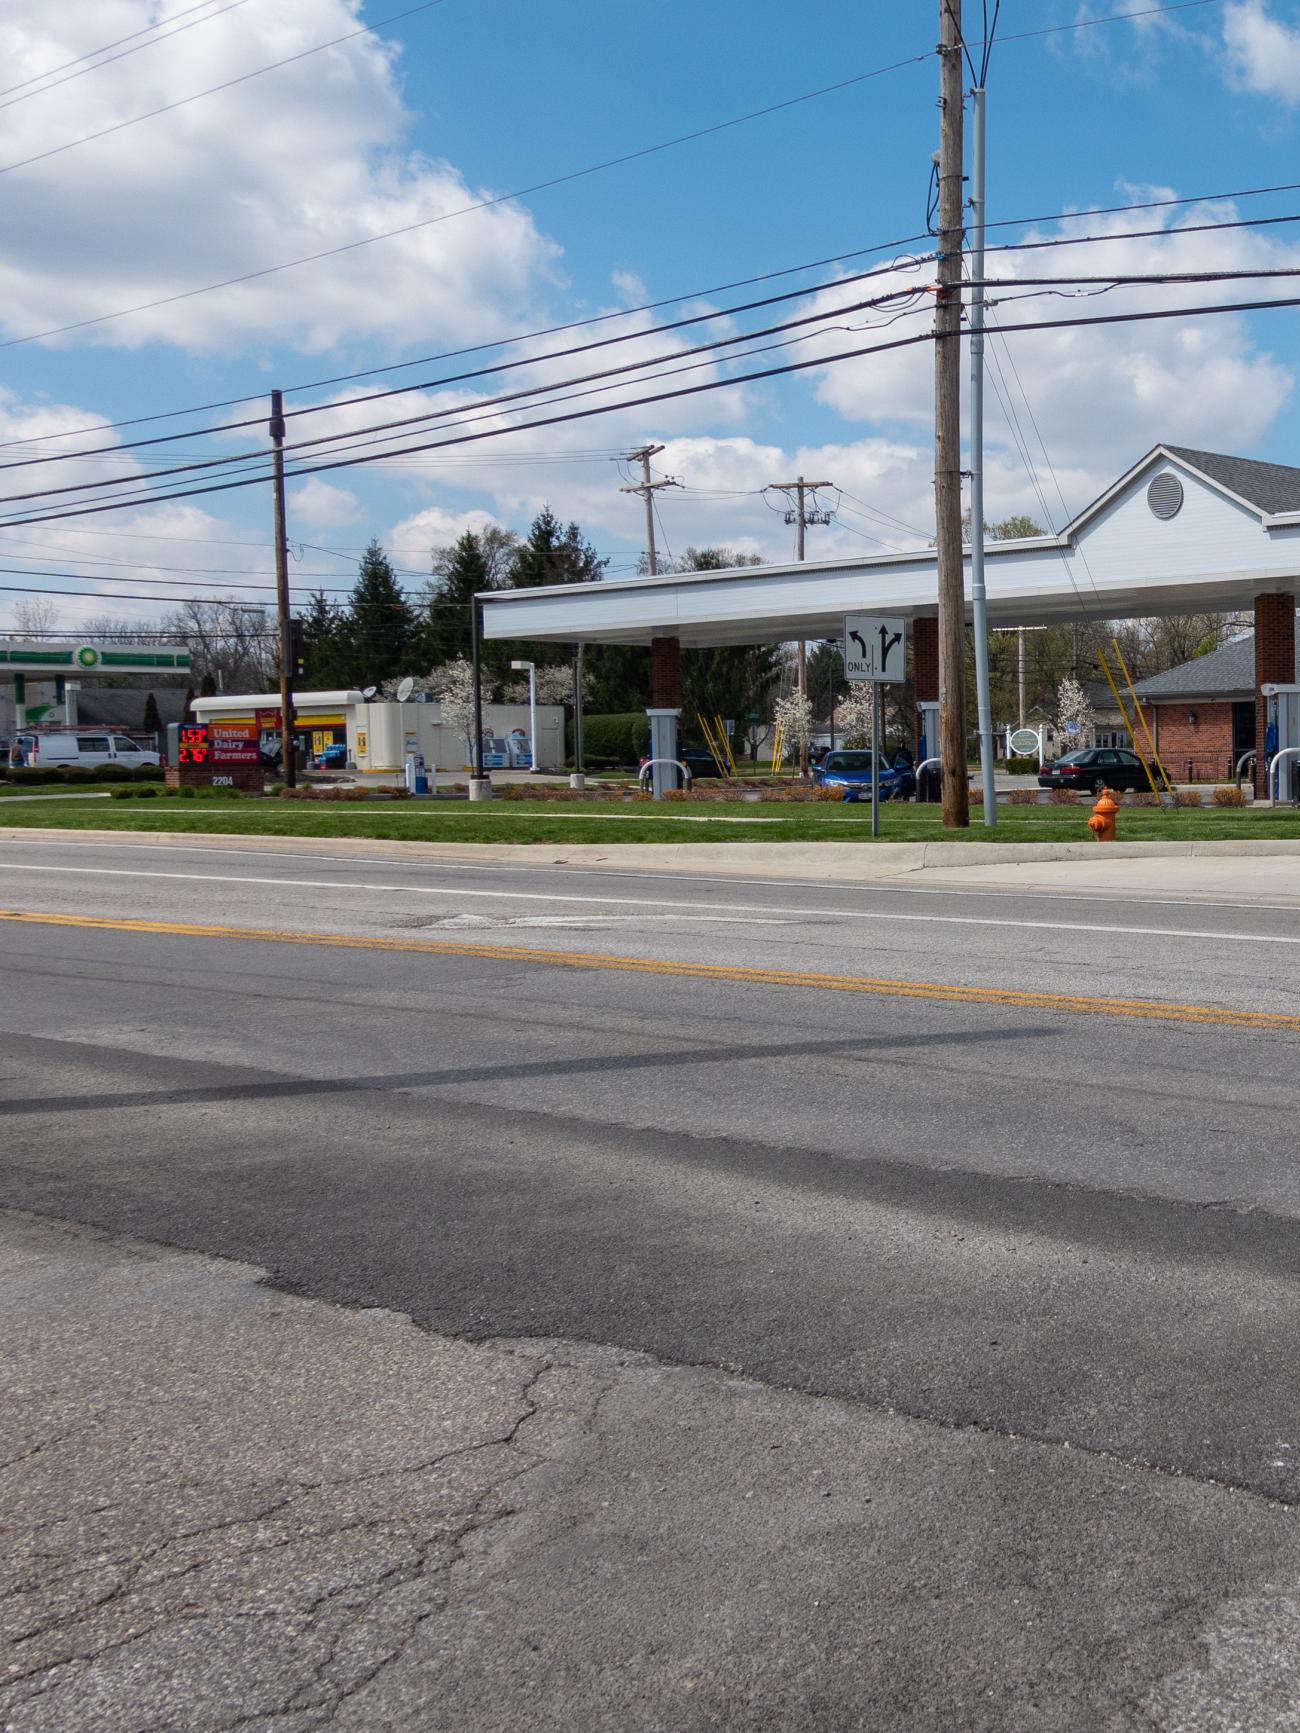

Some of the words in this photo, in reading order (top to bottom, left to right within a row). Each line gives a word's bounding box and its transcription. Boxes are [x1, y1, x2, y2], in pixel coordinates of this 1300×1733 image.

[847, 661, 871, 673] ONLY
[213, 729, 249, 738] United
[213, 740, 244, 750] Dairy
[214, 751, 257, 760] Farmers
[212, 776, 233, 786] 2204
